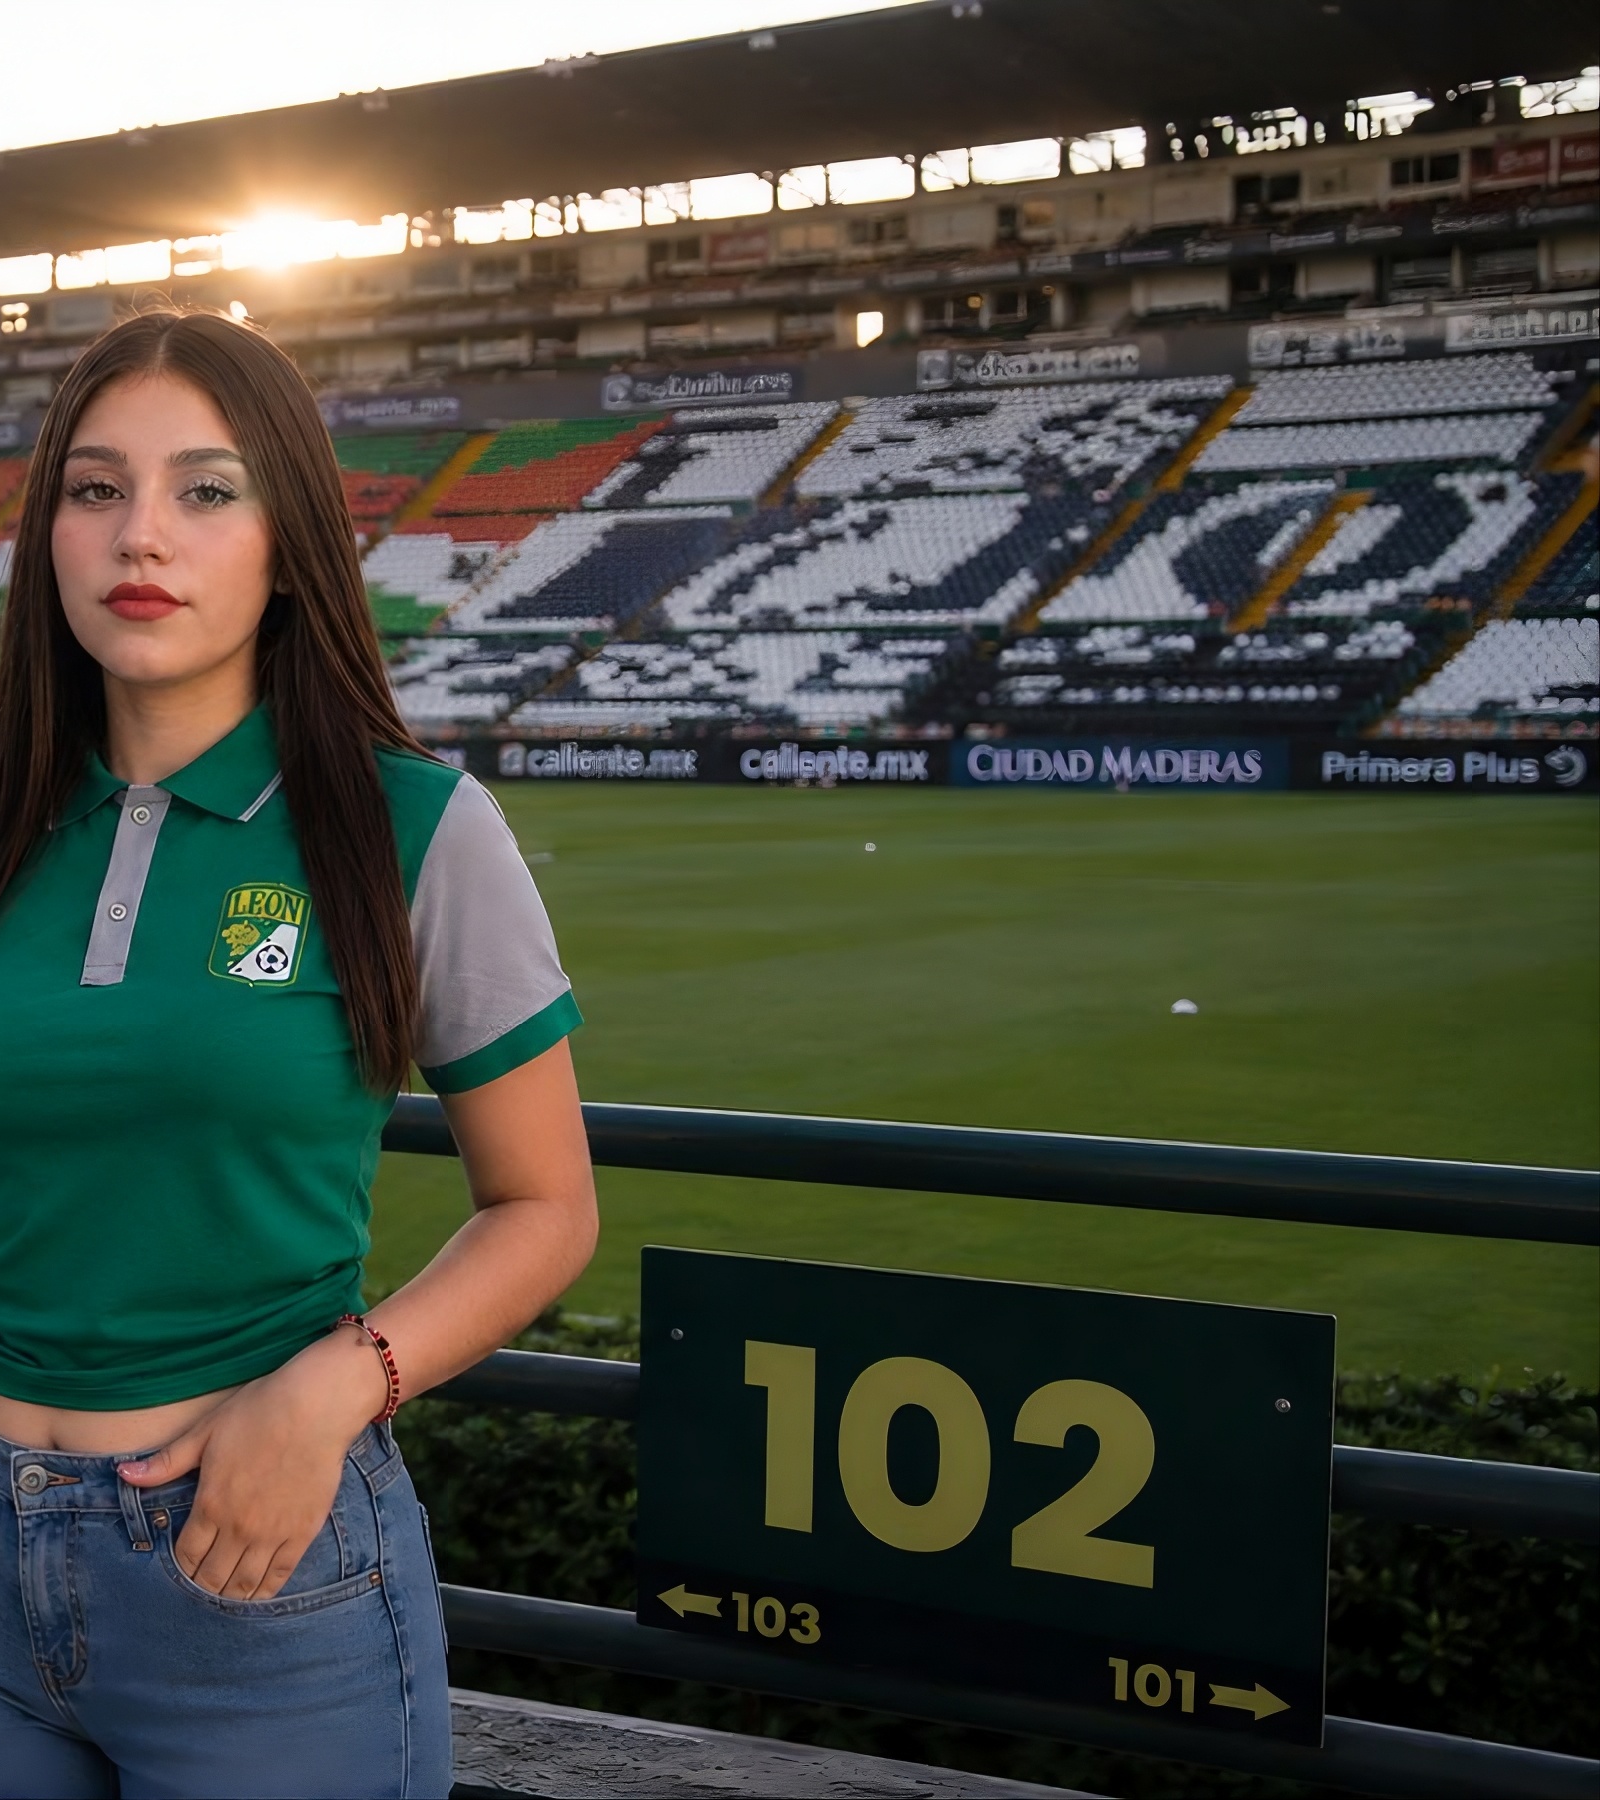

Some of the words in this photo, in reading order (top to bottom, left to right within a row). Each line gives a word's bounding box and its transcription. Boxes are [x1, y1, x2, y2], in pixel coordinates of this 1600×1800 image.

[967, 744, 1095, 782] CIUDAD
[1098, 746, 1262, 783] MADERAS
[1463, 751, 1540, 784] Plus
[233, 891, 301, 922] LEON
[745, 1340, 1155, 1589] 102
[732, 1592, 821, 1644] 103
[1108, 1656, 1195, 1713] 101
